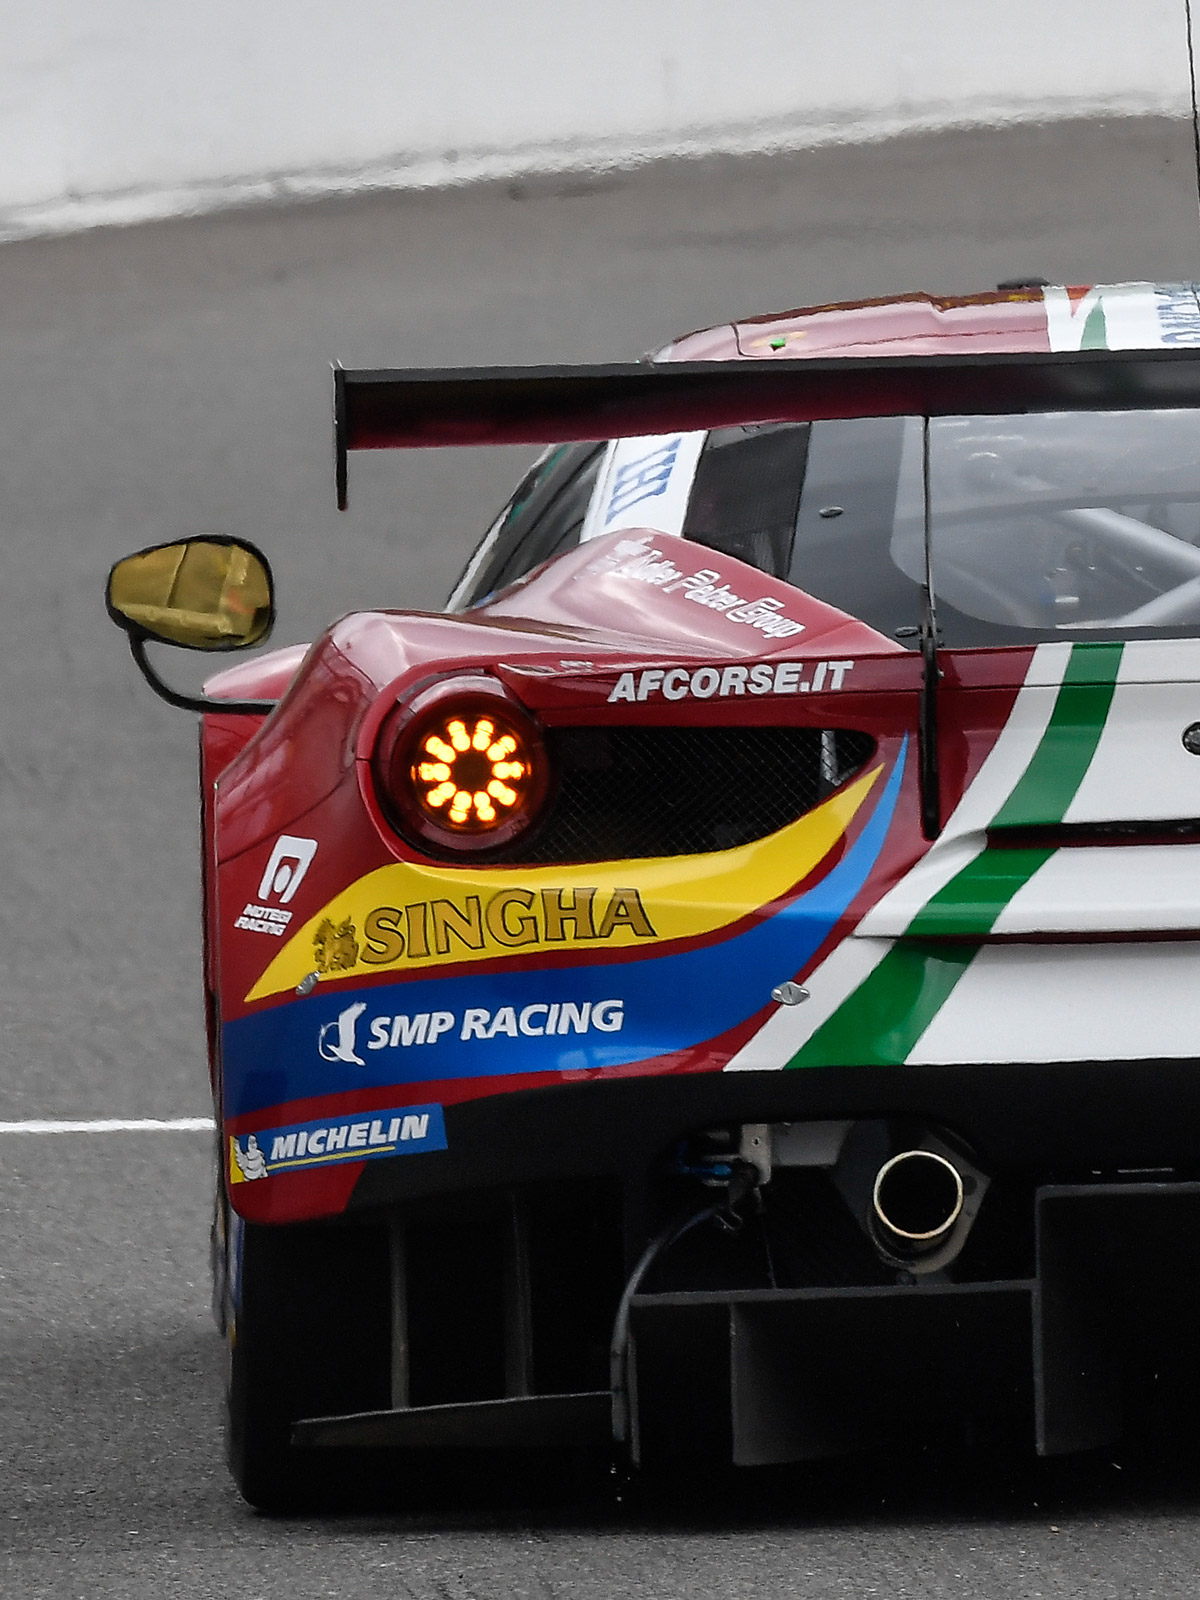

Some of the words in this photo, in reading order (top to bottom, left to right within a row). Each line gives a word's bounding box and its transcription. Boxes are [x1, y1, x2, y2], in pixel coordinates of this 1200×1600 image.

[725, 596, 806, 639] Group
[607, 660, 854, 703] AFCORSE.IT
[360, 886, 657, 965] SINGHA
[367, 1010, 455, 1050] SMP
[460, 1000, 625, 1041] RACING
[270, 1113, 430, 1161] MICHELIN
